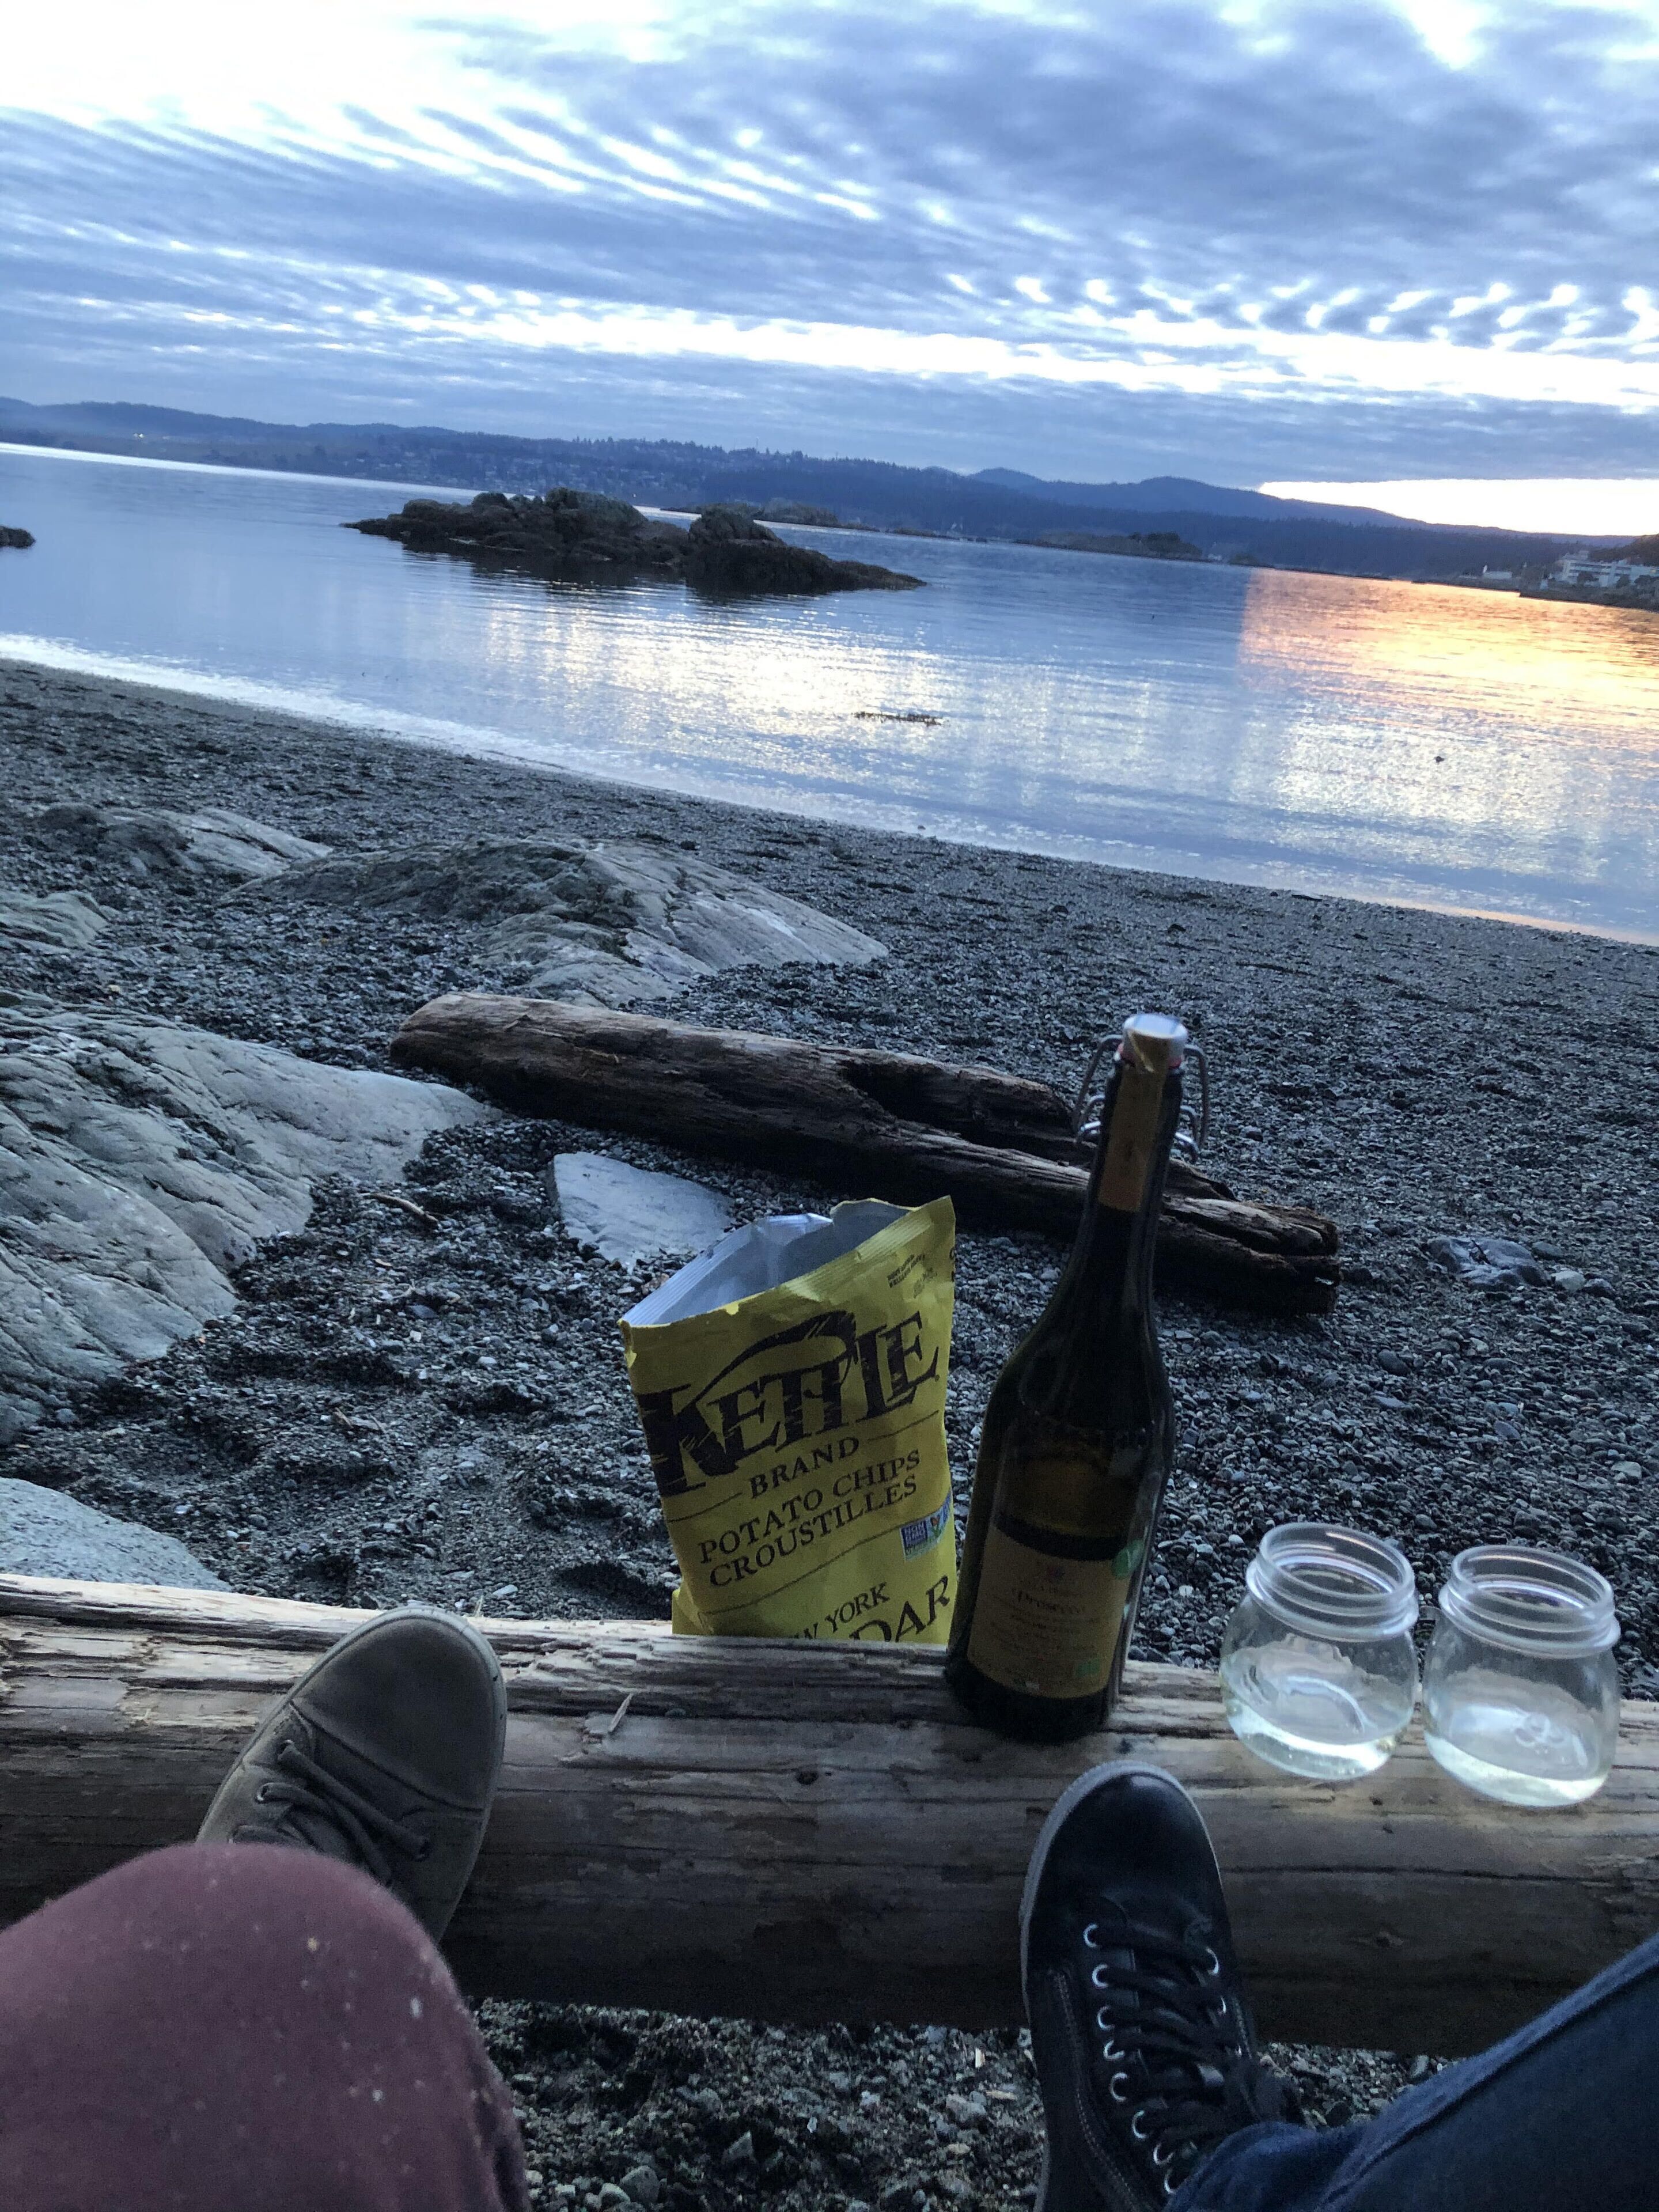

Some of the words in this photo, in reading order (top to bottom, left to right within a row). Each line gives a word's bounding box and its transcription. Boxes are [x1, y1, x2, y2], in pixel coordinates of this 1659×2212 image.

[636, 1310, 939, 1498] KETTLE
[698, 1489, 824, 1564] POTATO
[832, 1449, 921, 1498] CHIPS
[750, 1436, 859, 1499] BRAND
[709, 1473, 918, 1587] CROUSTILLES
[824, 1581, 891, 1634] YORK
